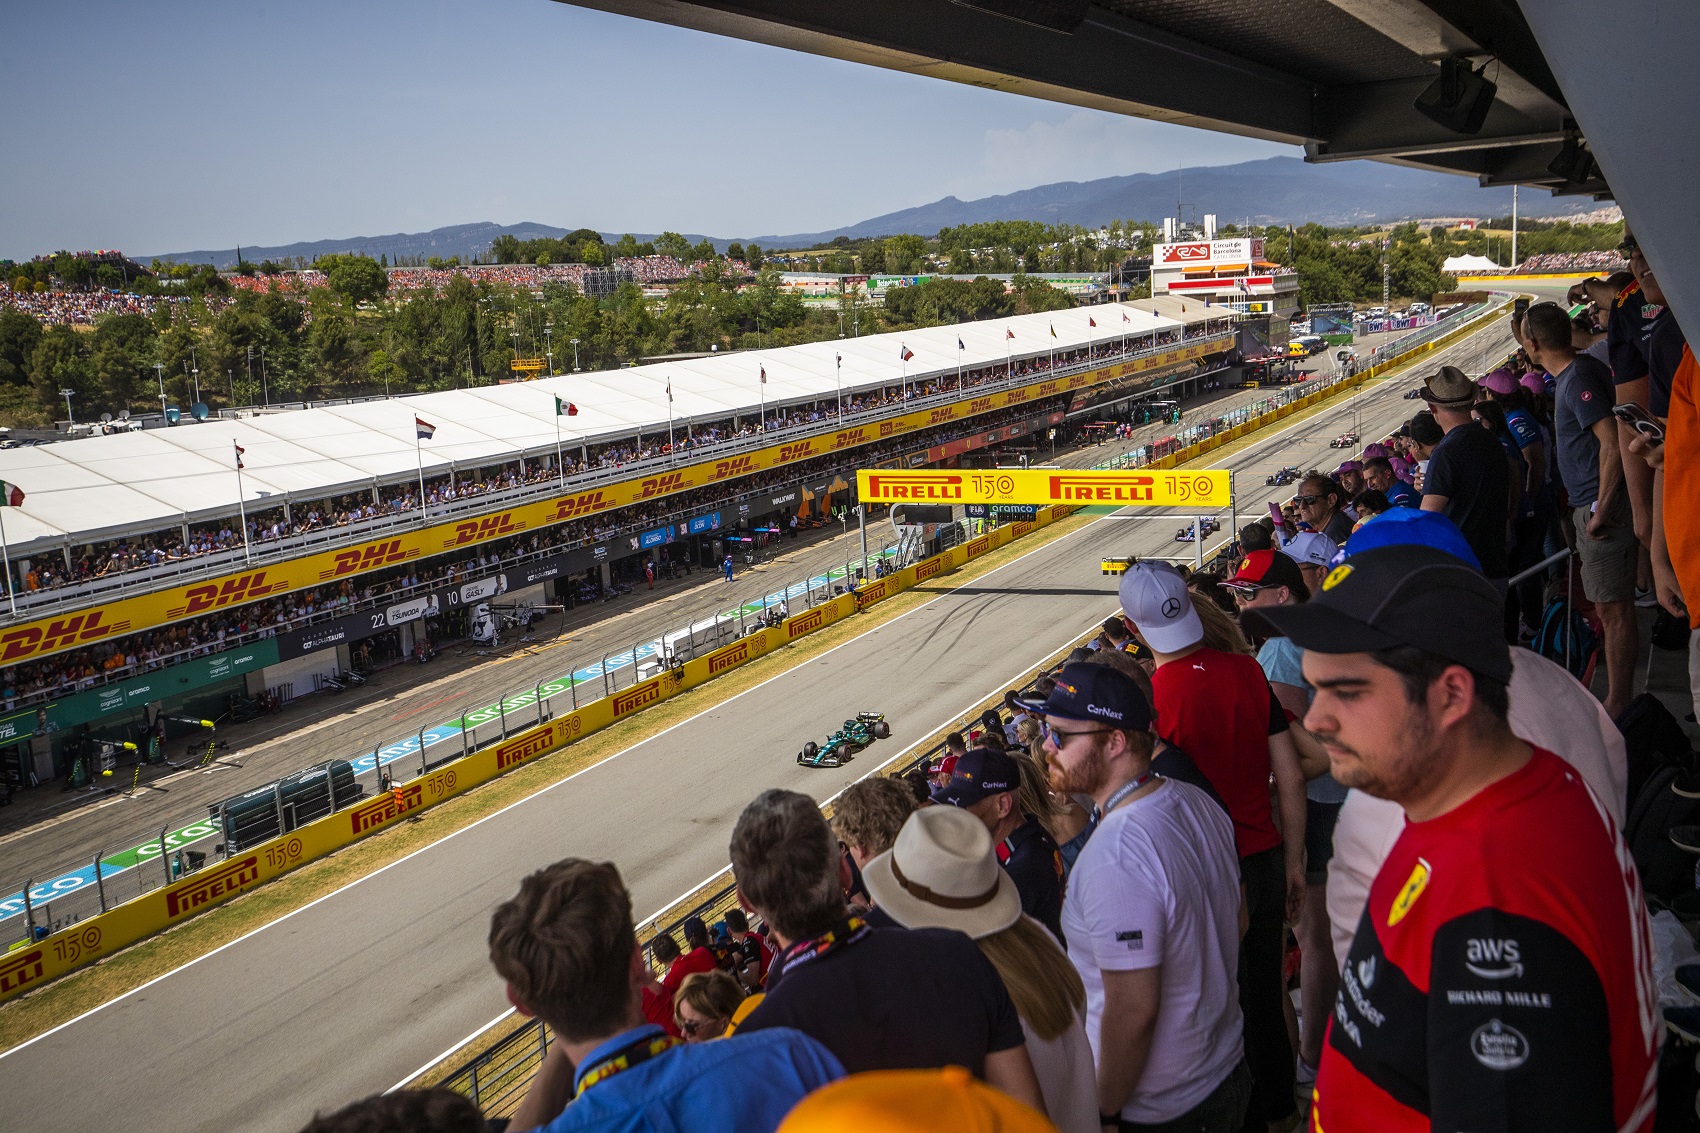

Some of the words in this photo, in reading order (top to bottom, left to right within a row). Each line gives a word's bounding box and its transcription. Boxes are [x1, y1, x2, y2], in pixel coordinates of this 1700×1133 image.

[877, 279, 900, 287] Heineken
[1369, 322, 1383, 331] BWT
[1396, 320, 1410, 328] BWT
[1007, 390, 1028, 404] DHL
[1039, 382, 1059, 396] DHL
[931, 407, 957, 423] DHL
[970, 398, 994, 413] DHL
[836, 429, 866, 448] DHL
[780, 441, 813, 462] DHL
[715, 456, 753, 479] DHL
[641, 473, 686, 498] DHL
[869, 475, 962, 499] PIRELLI
[972, 475, 1015, 500] 150
[1049, 476, 1154, 501] PIRELLI
[1165, 476, 1214, 501] 150
[555, 492, 607, 519] DHL
[772, 493, 796, 505] WALKWAY
[992, 505, 1032, 513] aramco
[1052, 504, 1070, 519] PIRELLI
[455, 513, 515, 545] DHL
[1012, 521, 1031, 537] PIRELLI
[967, 537, 989, 557] PIRELLI
[334, 540, 408, 576] DHL
[916, 558, 941, 580] PIRELLI
[185, 572, 274, 613] DHL
[447, 591, 458, 605] 10
[466, 588, 484, 599] GASLY
[371, 613, 385, 628] 22
[391, 607, 419, 620] TSUNODA
[788, 610, 822, 638] PIRELLI
[1, 611, 111, 661] DHL
[312, 632, 345, 646] ALPHATAURI
[234, 655, 253, 665] aramco
[709, 642, 747, 674] PIRELLI
[128, 686, 150, 696] aramco
[613, 681, 659, 717] PIRELLI
[1087, 704, 1123, 720] CarNext
[497, 727, 553, 770] PIRELLI
[557, 715, 581, 739] 150
[351, 784, 422, 834] PIRELI
[428, 770, 457, 797] 150
[166, 856, 258, 918] PIRELLI
[265, 838, 303, 869] 150
[53, 926, 102, 964] 150
[1466, 938, 1521, 962] aws
[1447, 990, 1503, 1005] RICHARD
[1505, 991, 1552, 1009] MILLE
